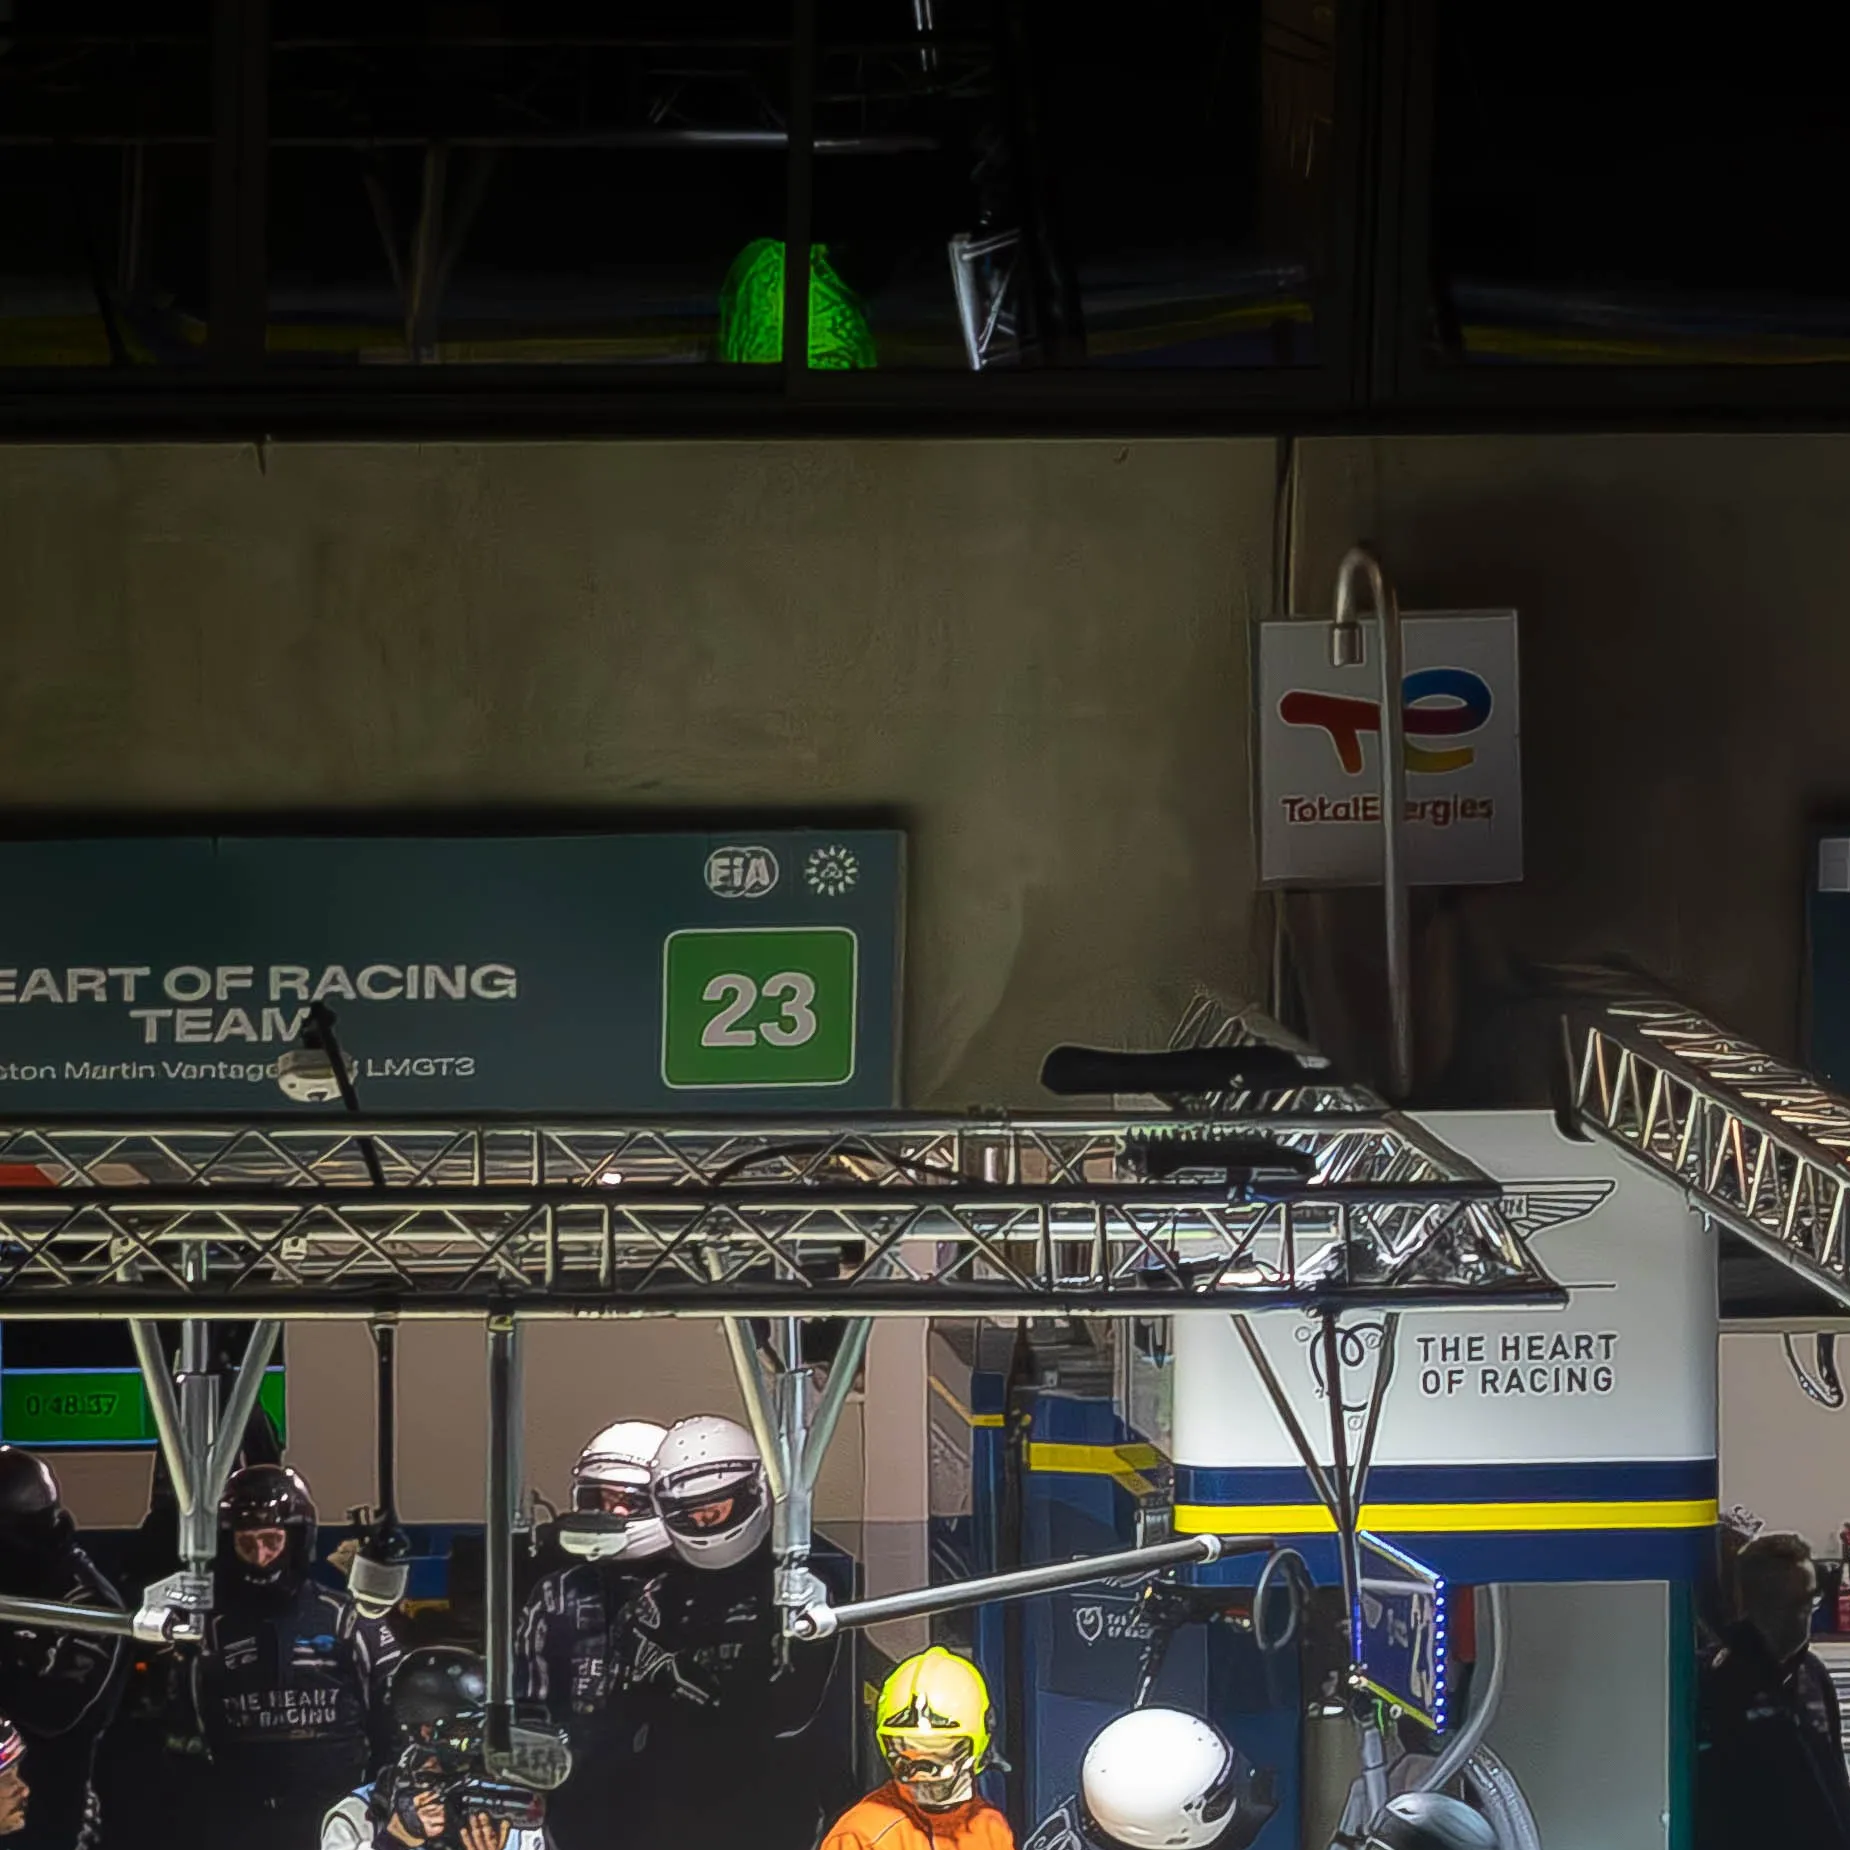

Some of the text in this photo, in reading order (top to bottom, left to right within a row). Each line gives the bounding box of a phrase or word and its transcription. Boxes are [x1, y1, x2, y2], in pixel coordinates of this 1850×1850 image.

[1281, 797, 1493, 826] TotalEergies
[709, 854, 772, 889] FIA
[162, 964, 254, 1002] OF
[269, 963, 518, 1001] RACING
[701, 972, 816, 1047] 23
[129, 1007, 311, 1045] TEAM
[64, 1060, 156, 1081] Martin
[366, 1057, 477, 1078] LMGT3
[1417, 1333, 1618, 1362] THE HEART
[1421, 1366, 1613, 1395] OF RACING
